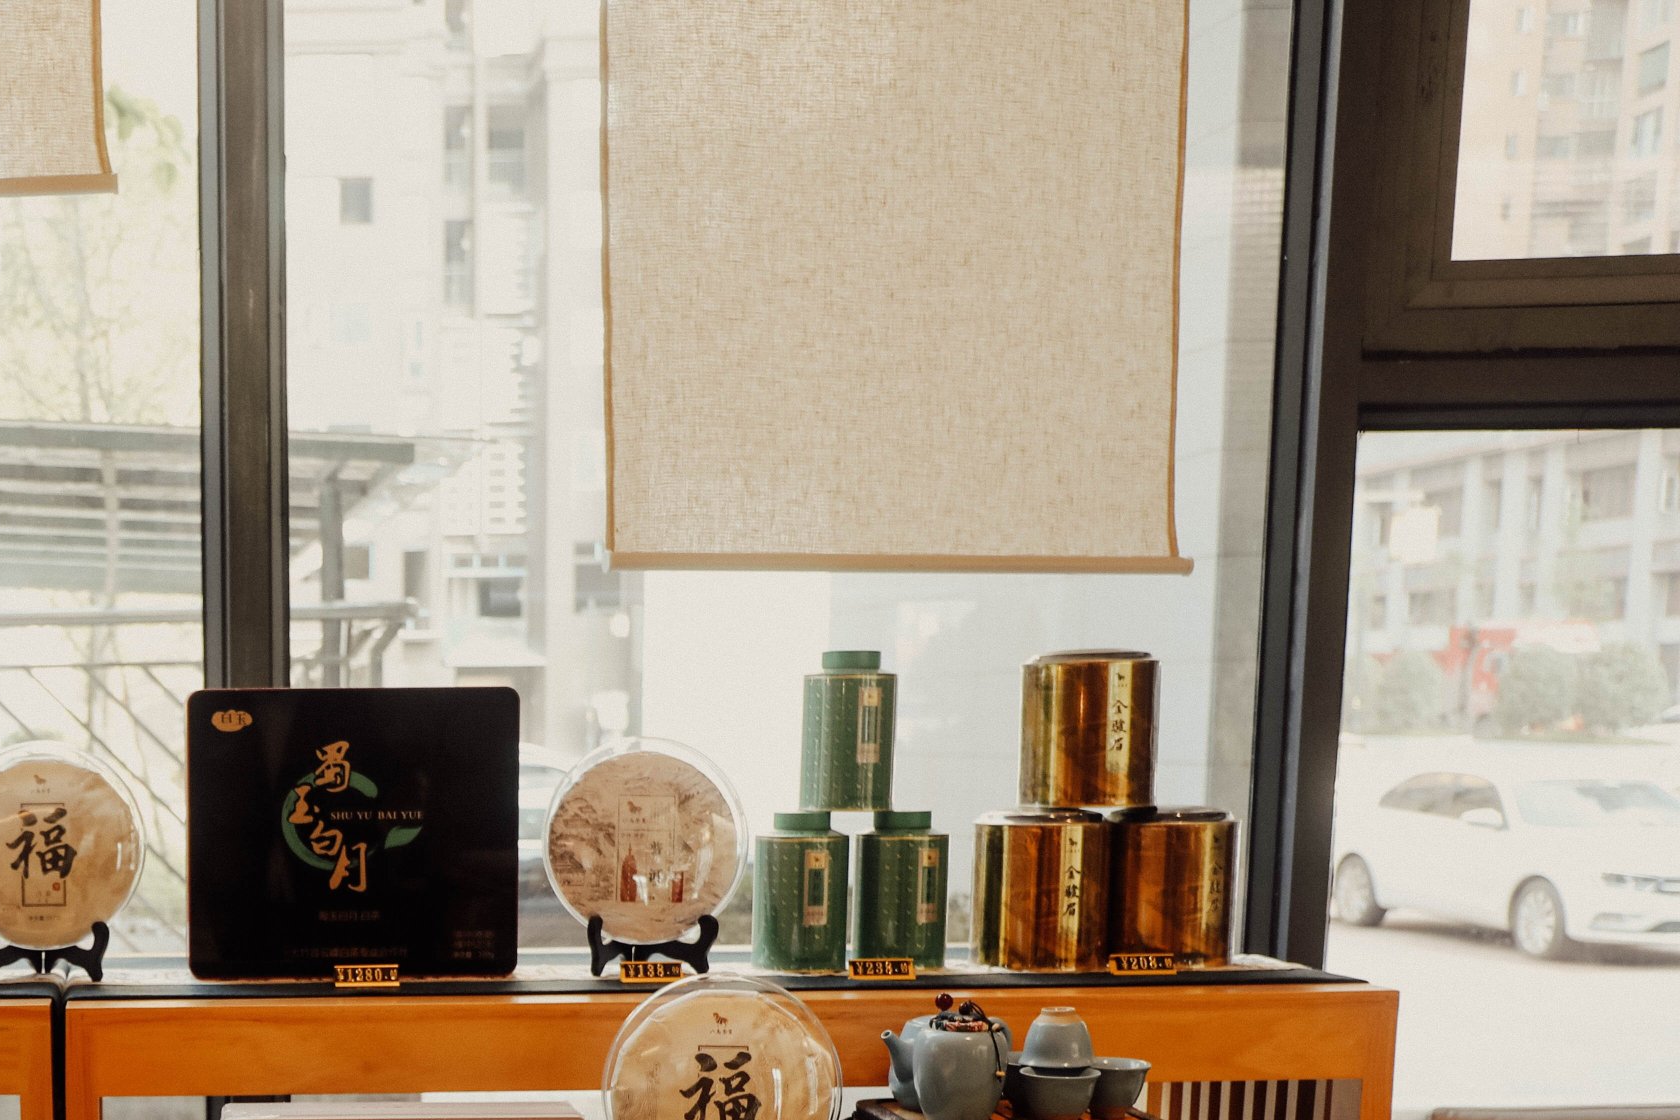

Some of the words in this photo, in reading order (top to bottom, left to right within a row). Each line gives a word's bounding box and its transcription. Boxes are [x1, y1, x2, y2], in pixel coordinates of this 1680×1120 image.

[330, 811, 353, 820] SHU
[357, 811, 372, 820] YU
[378, 811, 397, 820] BAI
[401, 811, 424, 820] YUE
[5, 807, 78, 880] 福
